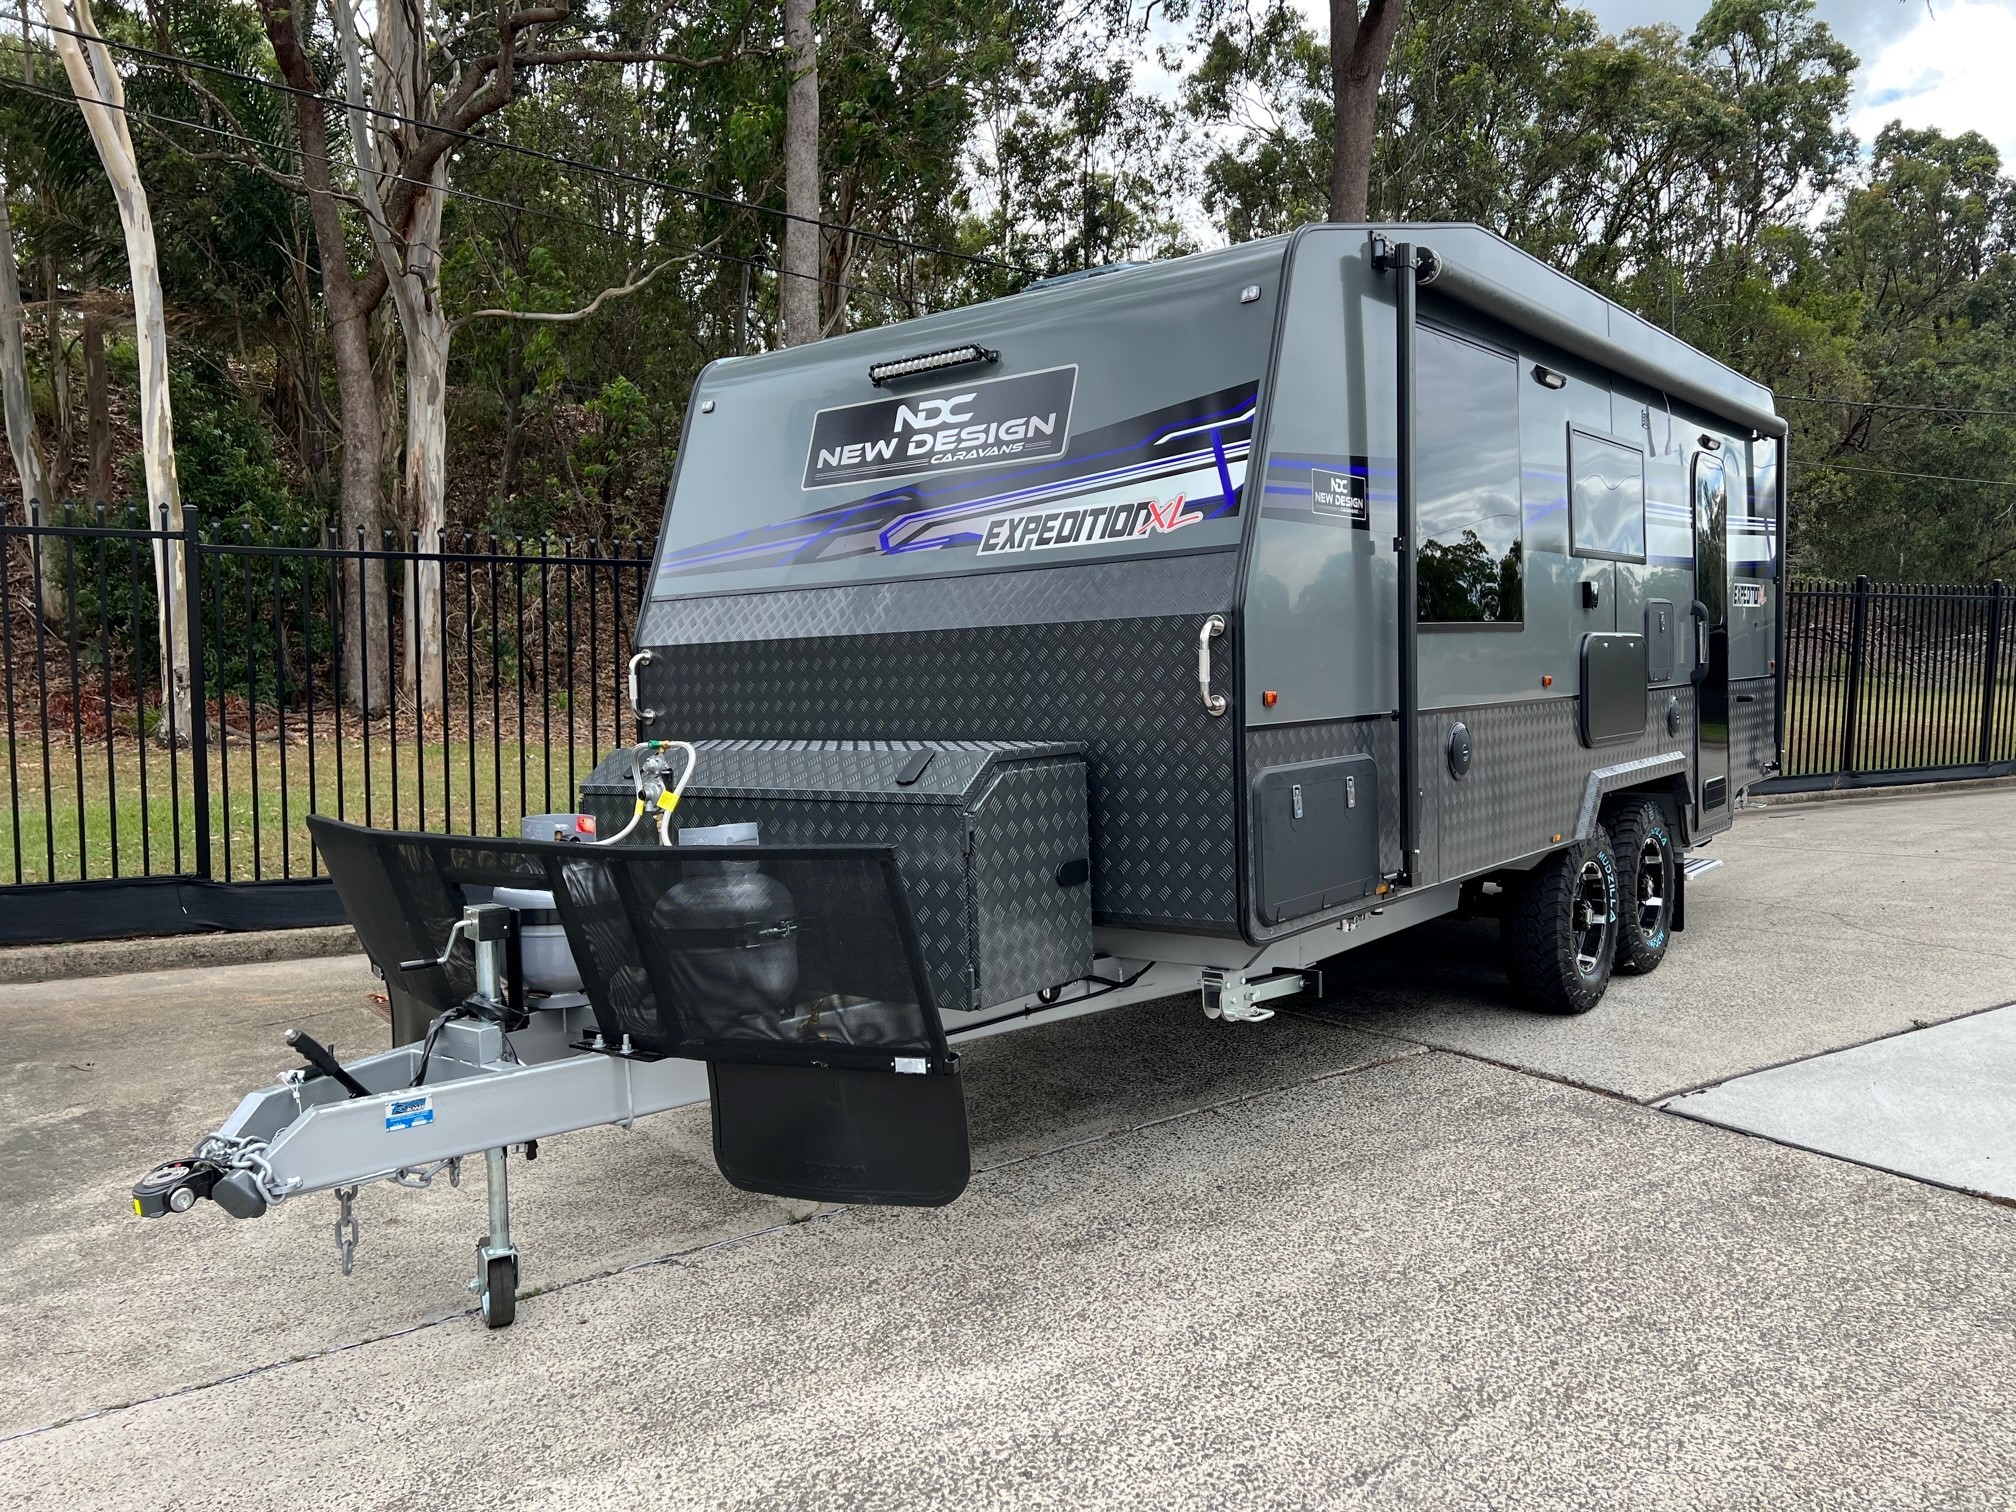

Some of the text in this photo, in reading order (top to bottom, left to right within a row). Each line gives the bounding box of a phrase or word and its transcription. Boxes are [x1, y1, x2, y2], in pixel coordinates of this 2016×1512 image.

[893, 392, 978, 433] NDC
[817, 412, 1057, 469] NEW DESIGN
[930, 441, 1026, 465] CARAVANS
[1315, 491, 1363, 509] NEW DESIGN
[1330, 477, 1348, 493] NDC
[1596, 850, 1618, 924] MUDZILLA
